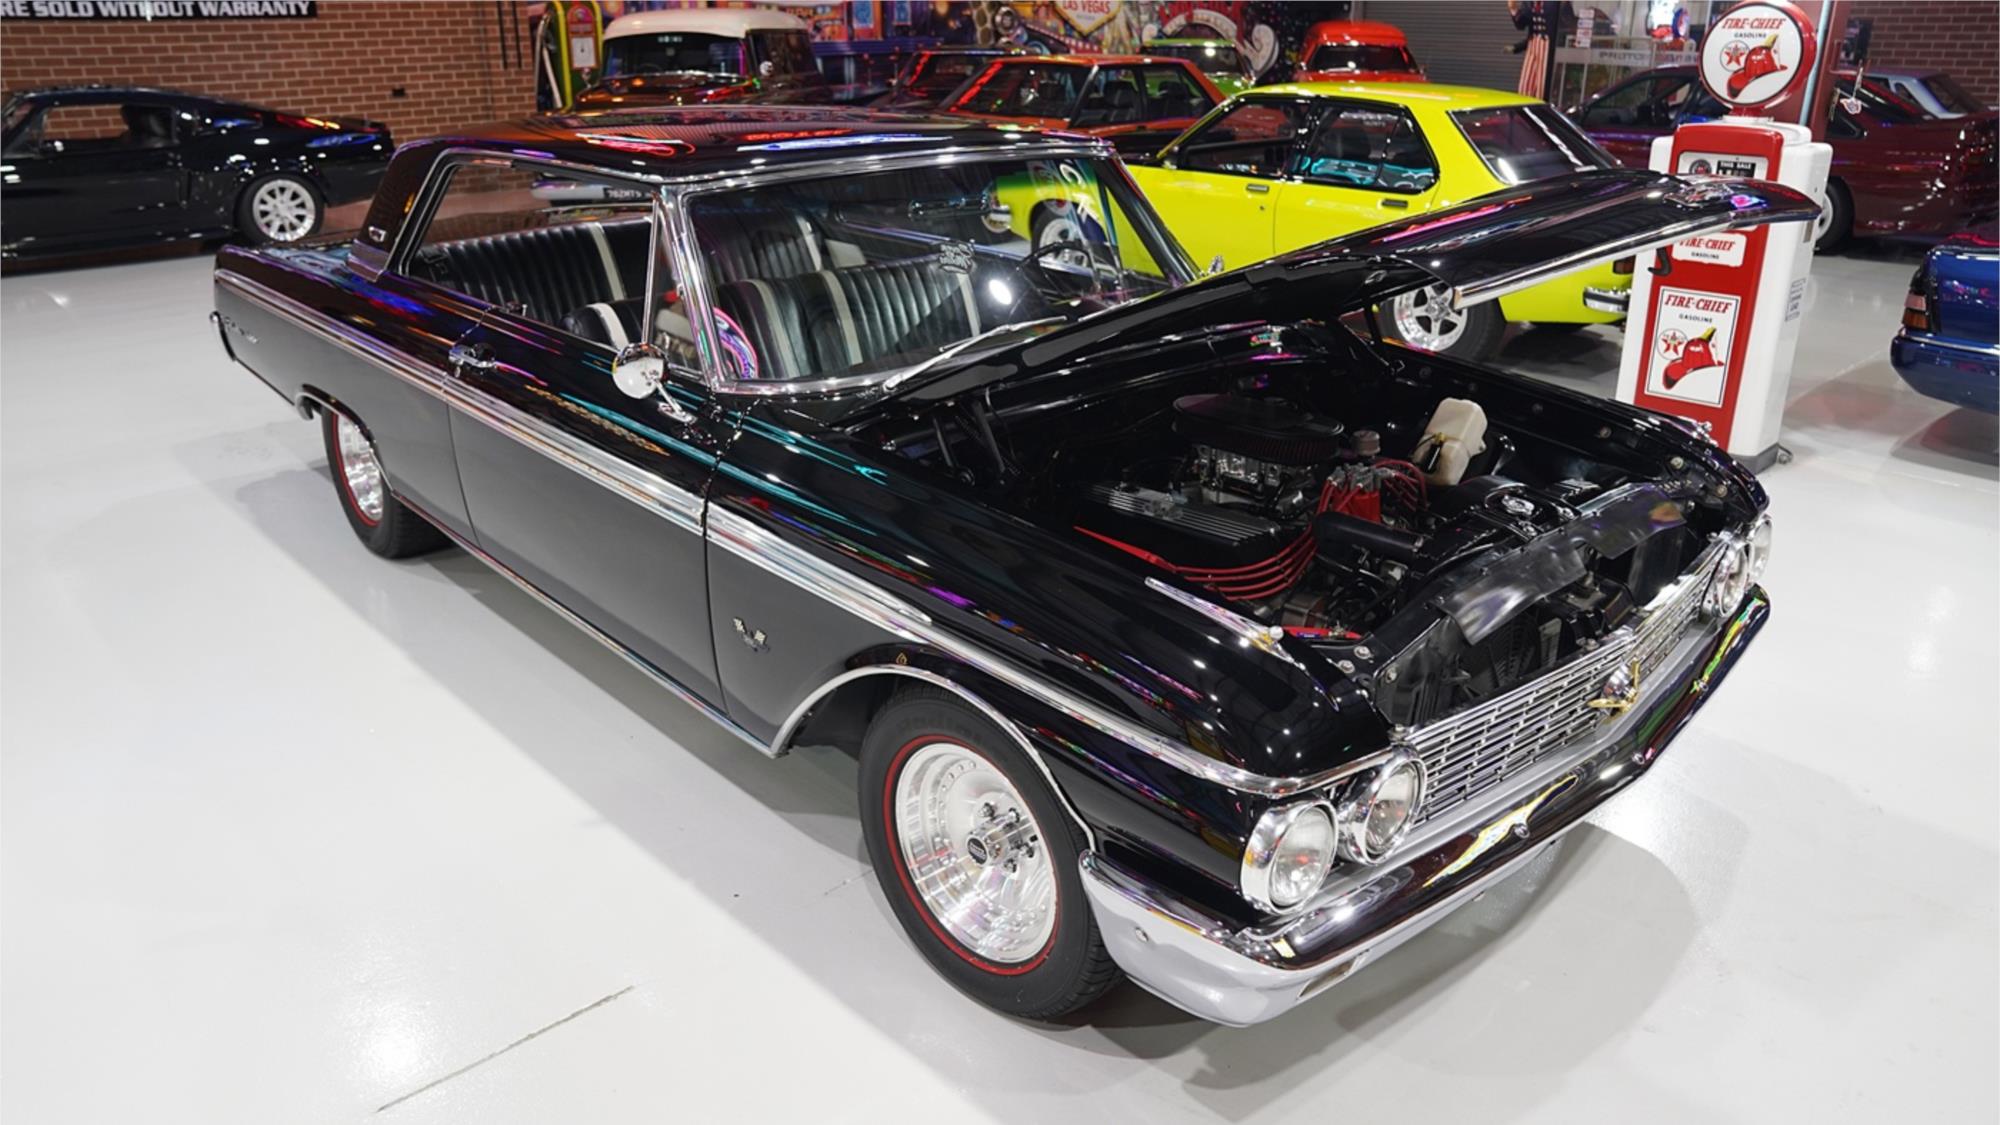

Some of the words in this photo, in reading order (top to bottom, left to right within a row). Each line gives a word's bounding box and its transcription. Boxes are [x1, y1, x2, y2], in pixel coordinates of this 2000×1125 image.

[32, 1, 94, 17] SOLD
[97, 1, 194, 17] WITHOUT
[197, 1, 310, 16] WARRANTY
[1722, 17, 1786, 29] FIRE-CHIEF
[1734, 31, 1766, 39] GASOLINE
[1664, 293, 1732, 314] FIRE-CHIEF
[1679, 313, 1713, 323] GASOLINE
